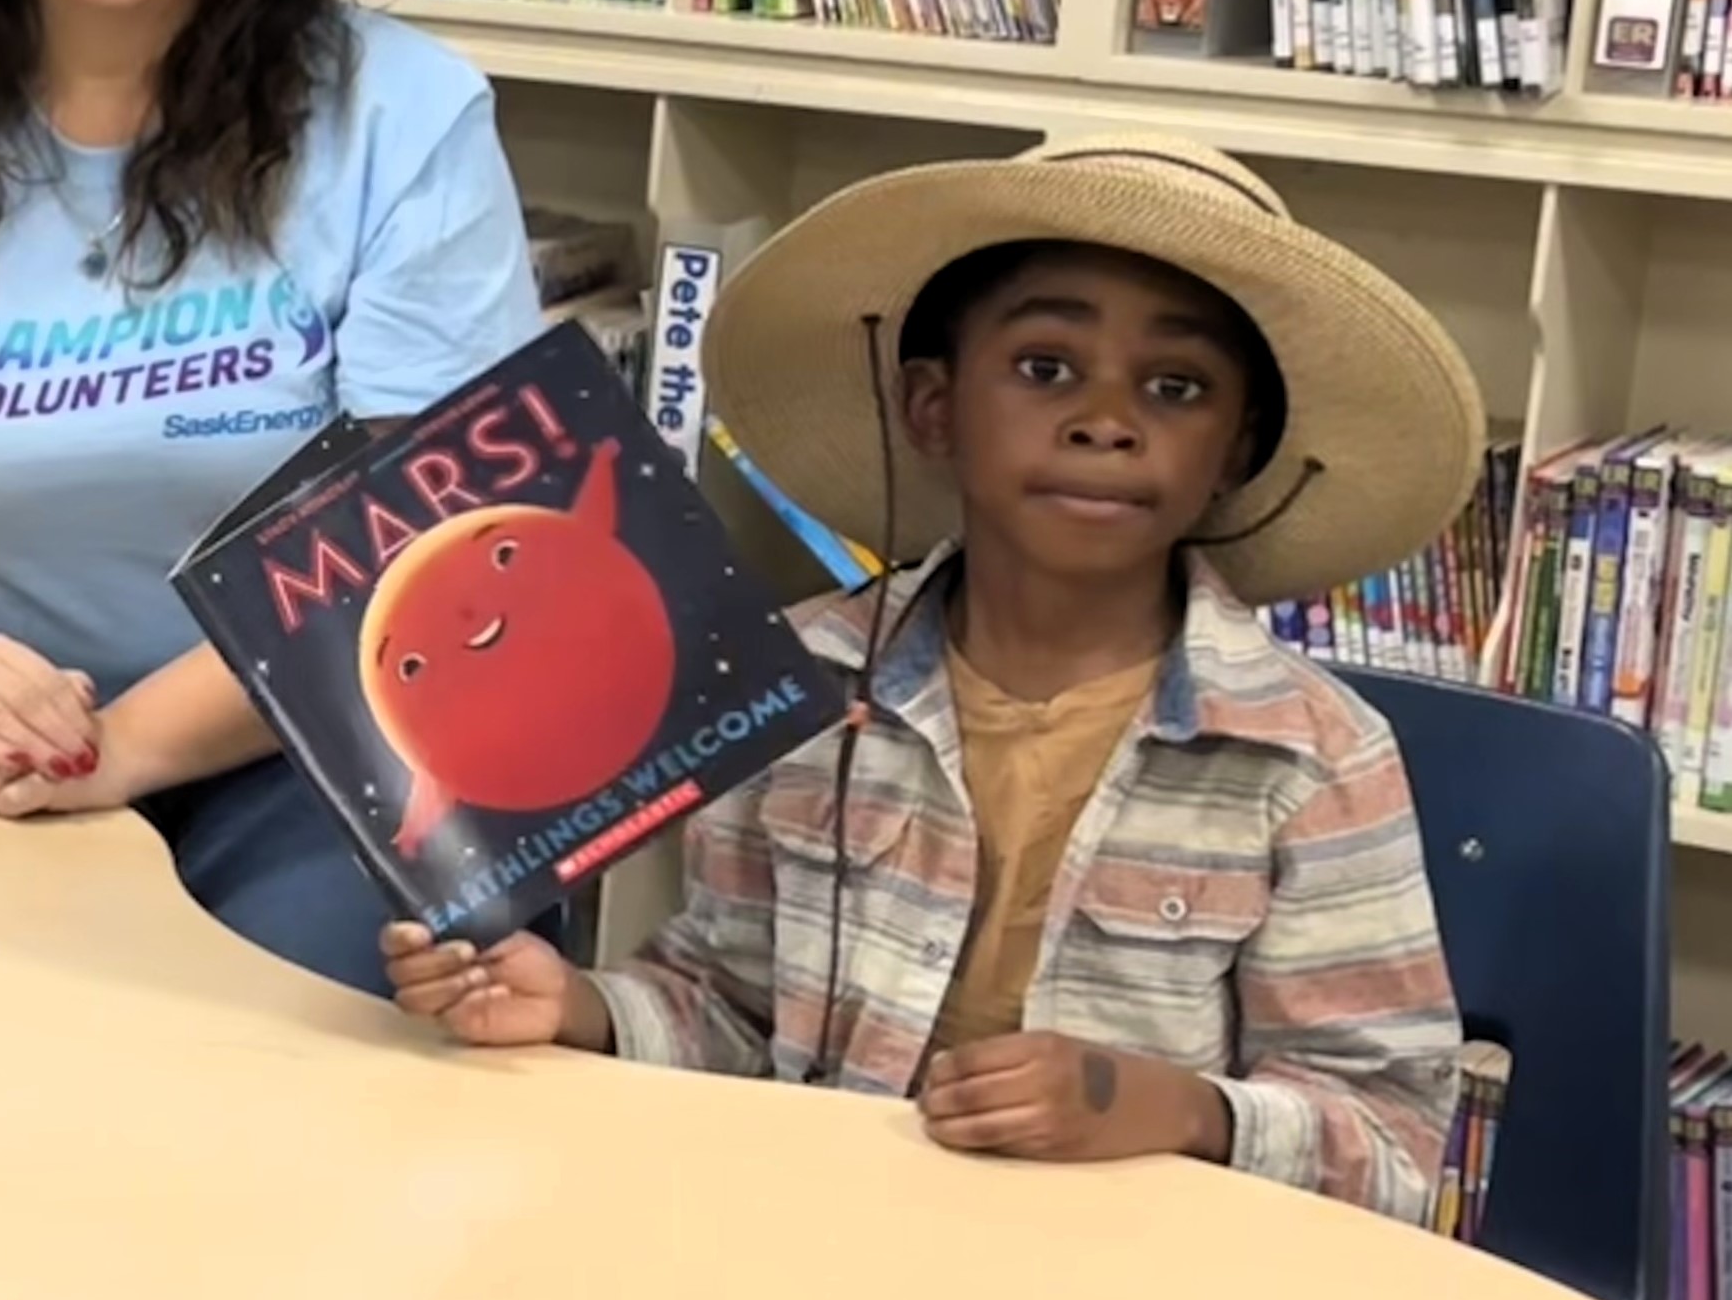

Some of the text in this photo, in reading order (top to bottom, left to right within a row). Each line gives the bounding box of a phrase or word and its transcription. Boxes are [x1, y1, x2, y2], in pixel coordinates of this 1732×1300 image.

[1612, 20, 1655, 46] ER
[163, 404, 326, 439] SaskEnergy
[656, 251, 710, 431] Pete the
[257, 382, 578, 634] MARS!
[422, 675, 807, 935] EARTHLINGS WELCOME
